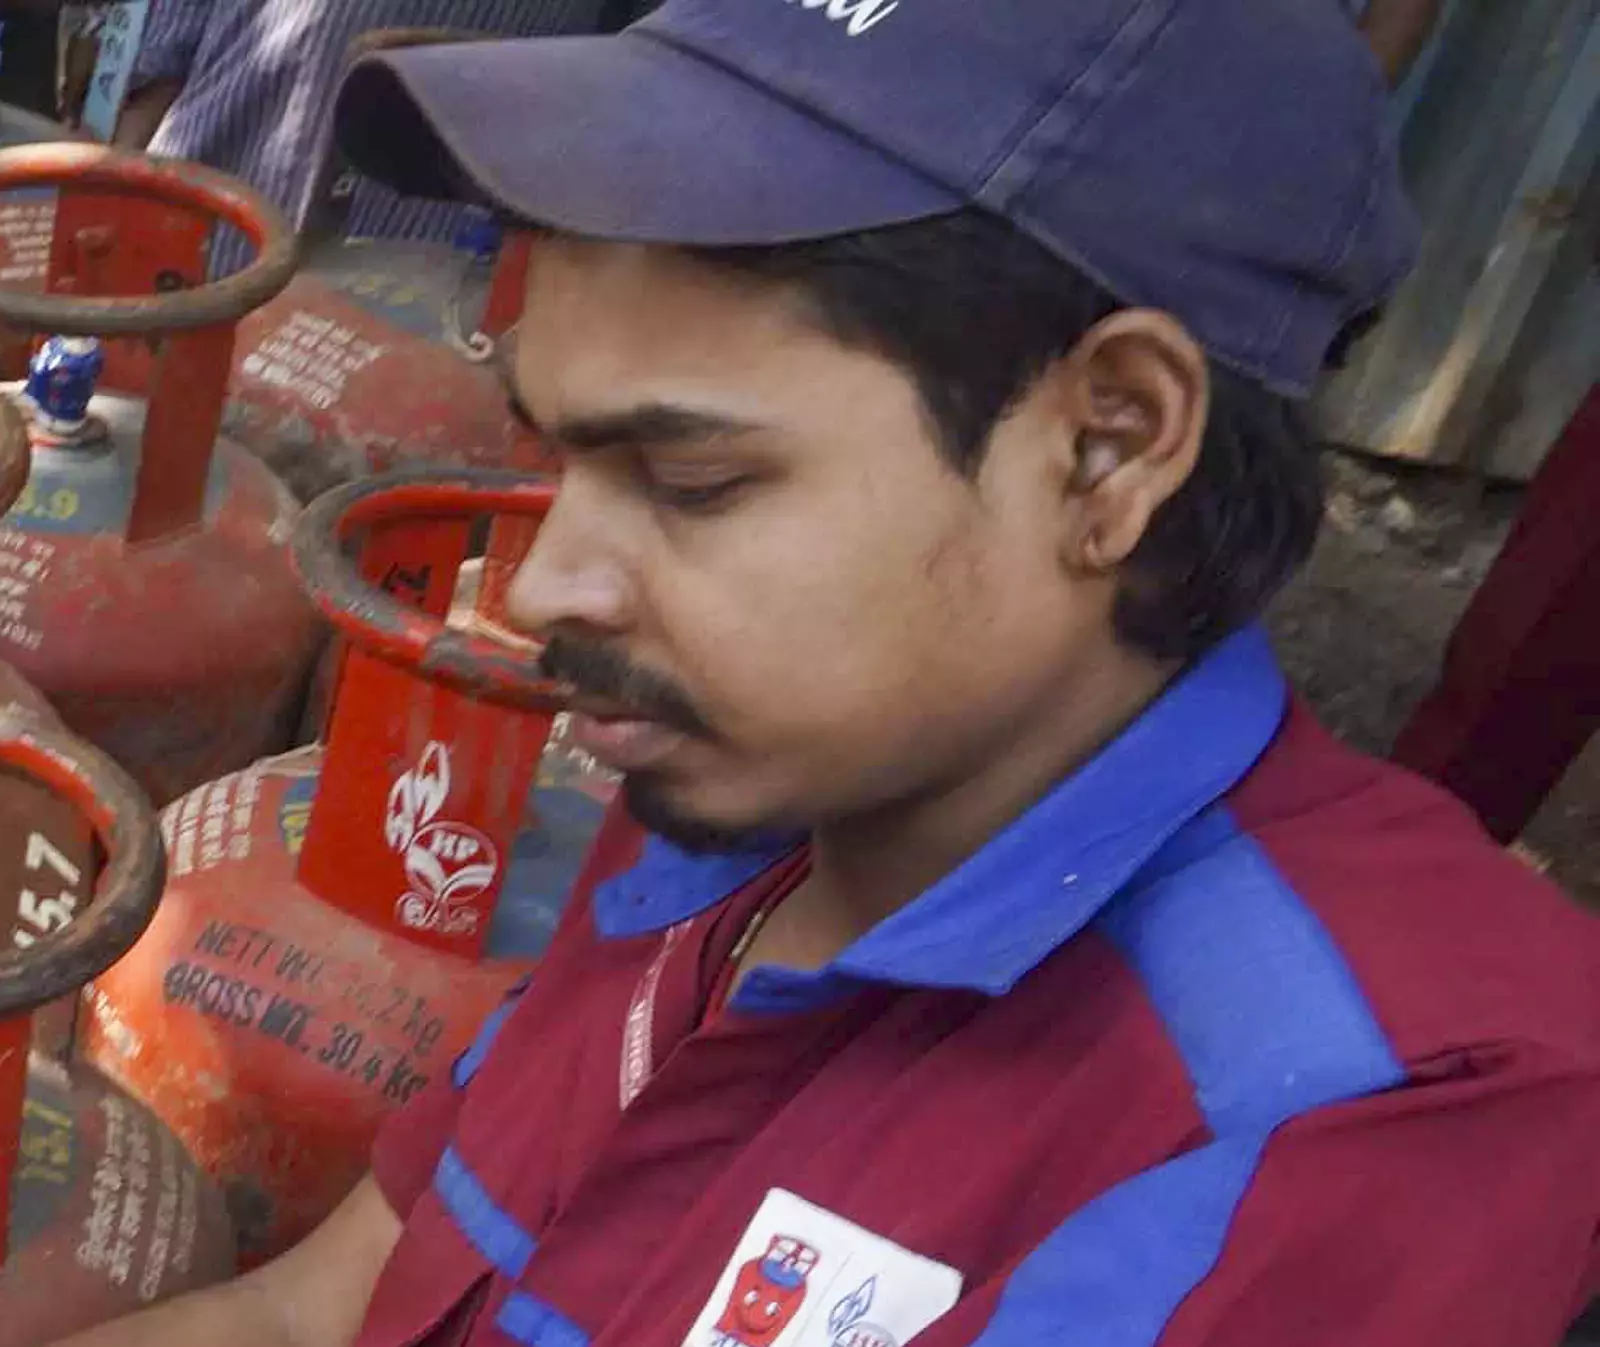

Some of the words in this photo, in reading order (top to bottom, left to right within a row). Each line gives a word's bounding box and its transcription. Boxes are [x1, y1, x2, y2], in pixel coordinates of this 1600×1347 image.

[429, 829, 480, 862] HP
[194, 919, 272, 968] NETT
[162, 958, 262, 1029] GROSS
[318, 1020, 384, 1086] 30.4
